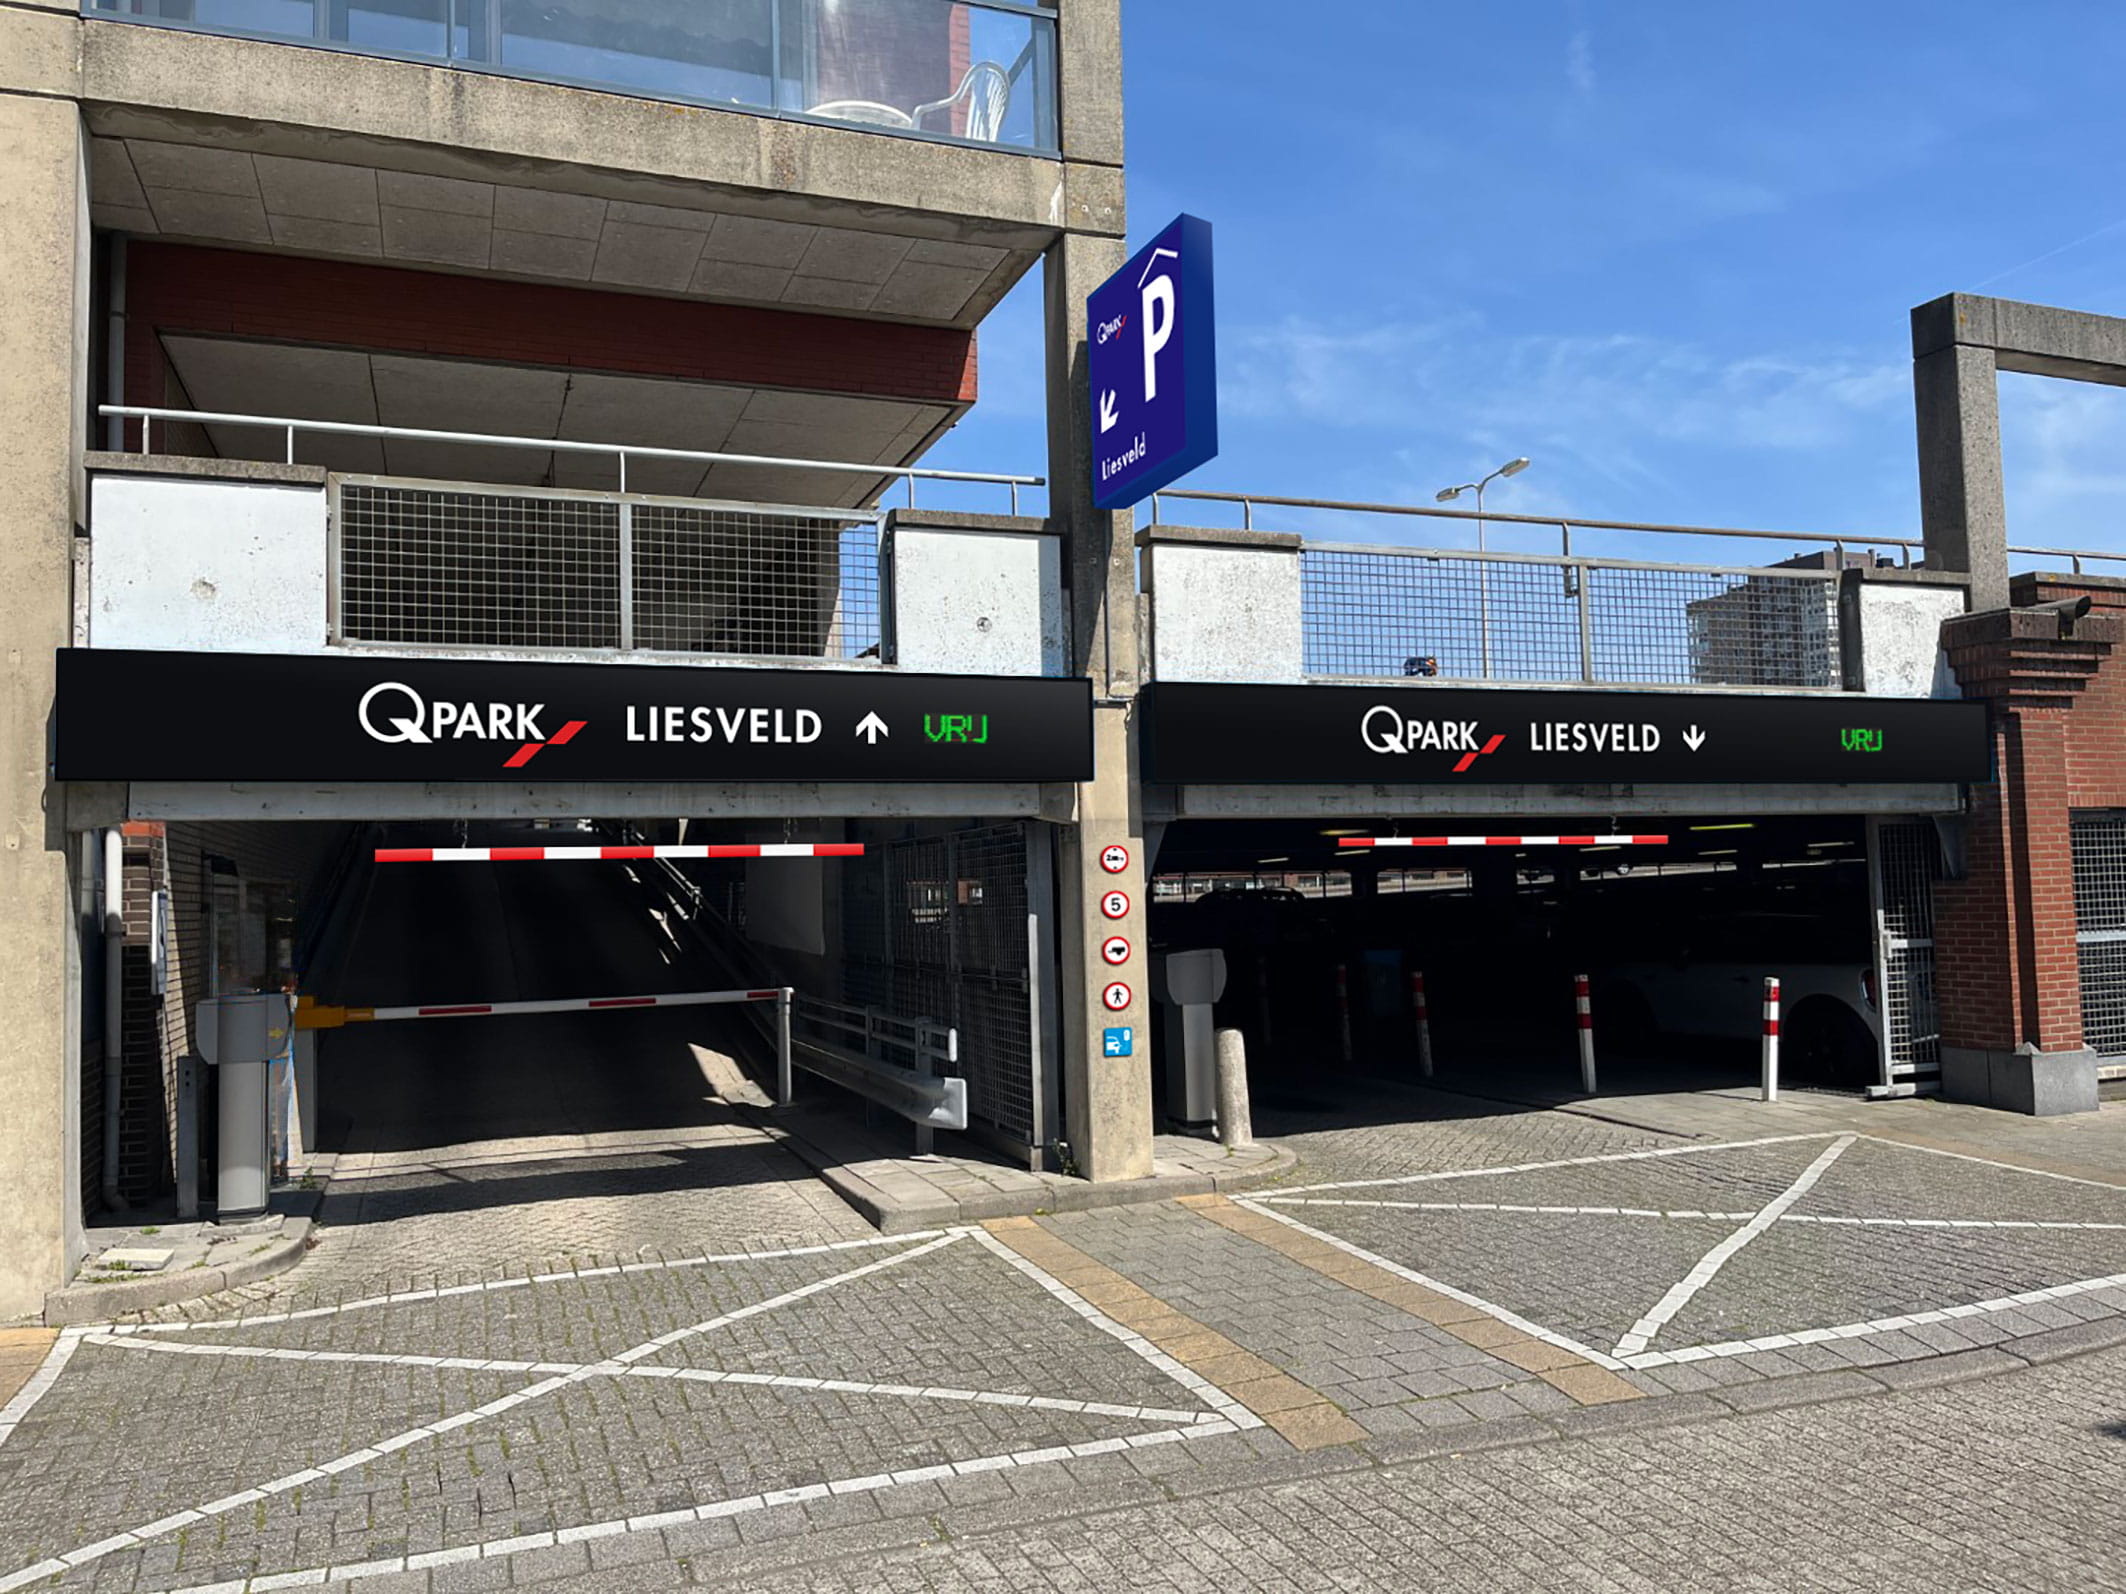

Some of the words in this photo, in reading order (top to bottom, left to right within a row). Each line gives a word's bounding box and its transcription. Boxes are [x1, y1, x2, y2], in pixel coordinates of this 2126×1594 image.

[1142, 274, 1174, 402] P
[1101, 432, 1146, 480] Liesveld
[626, 706, 823, 743] LIESVELD
[1530, 723, 1660, 752] LIESVELD
[1112, 898, 1121, 911] 5
